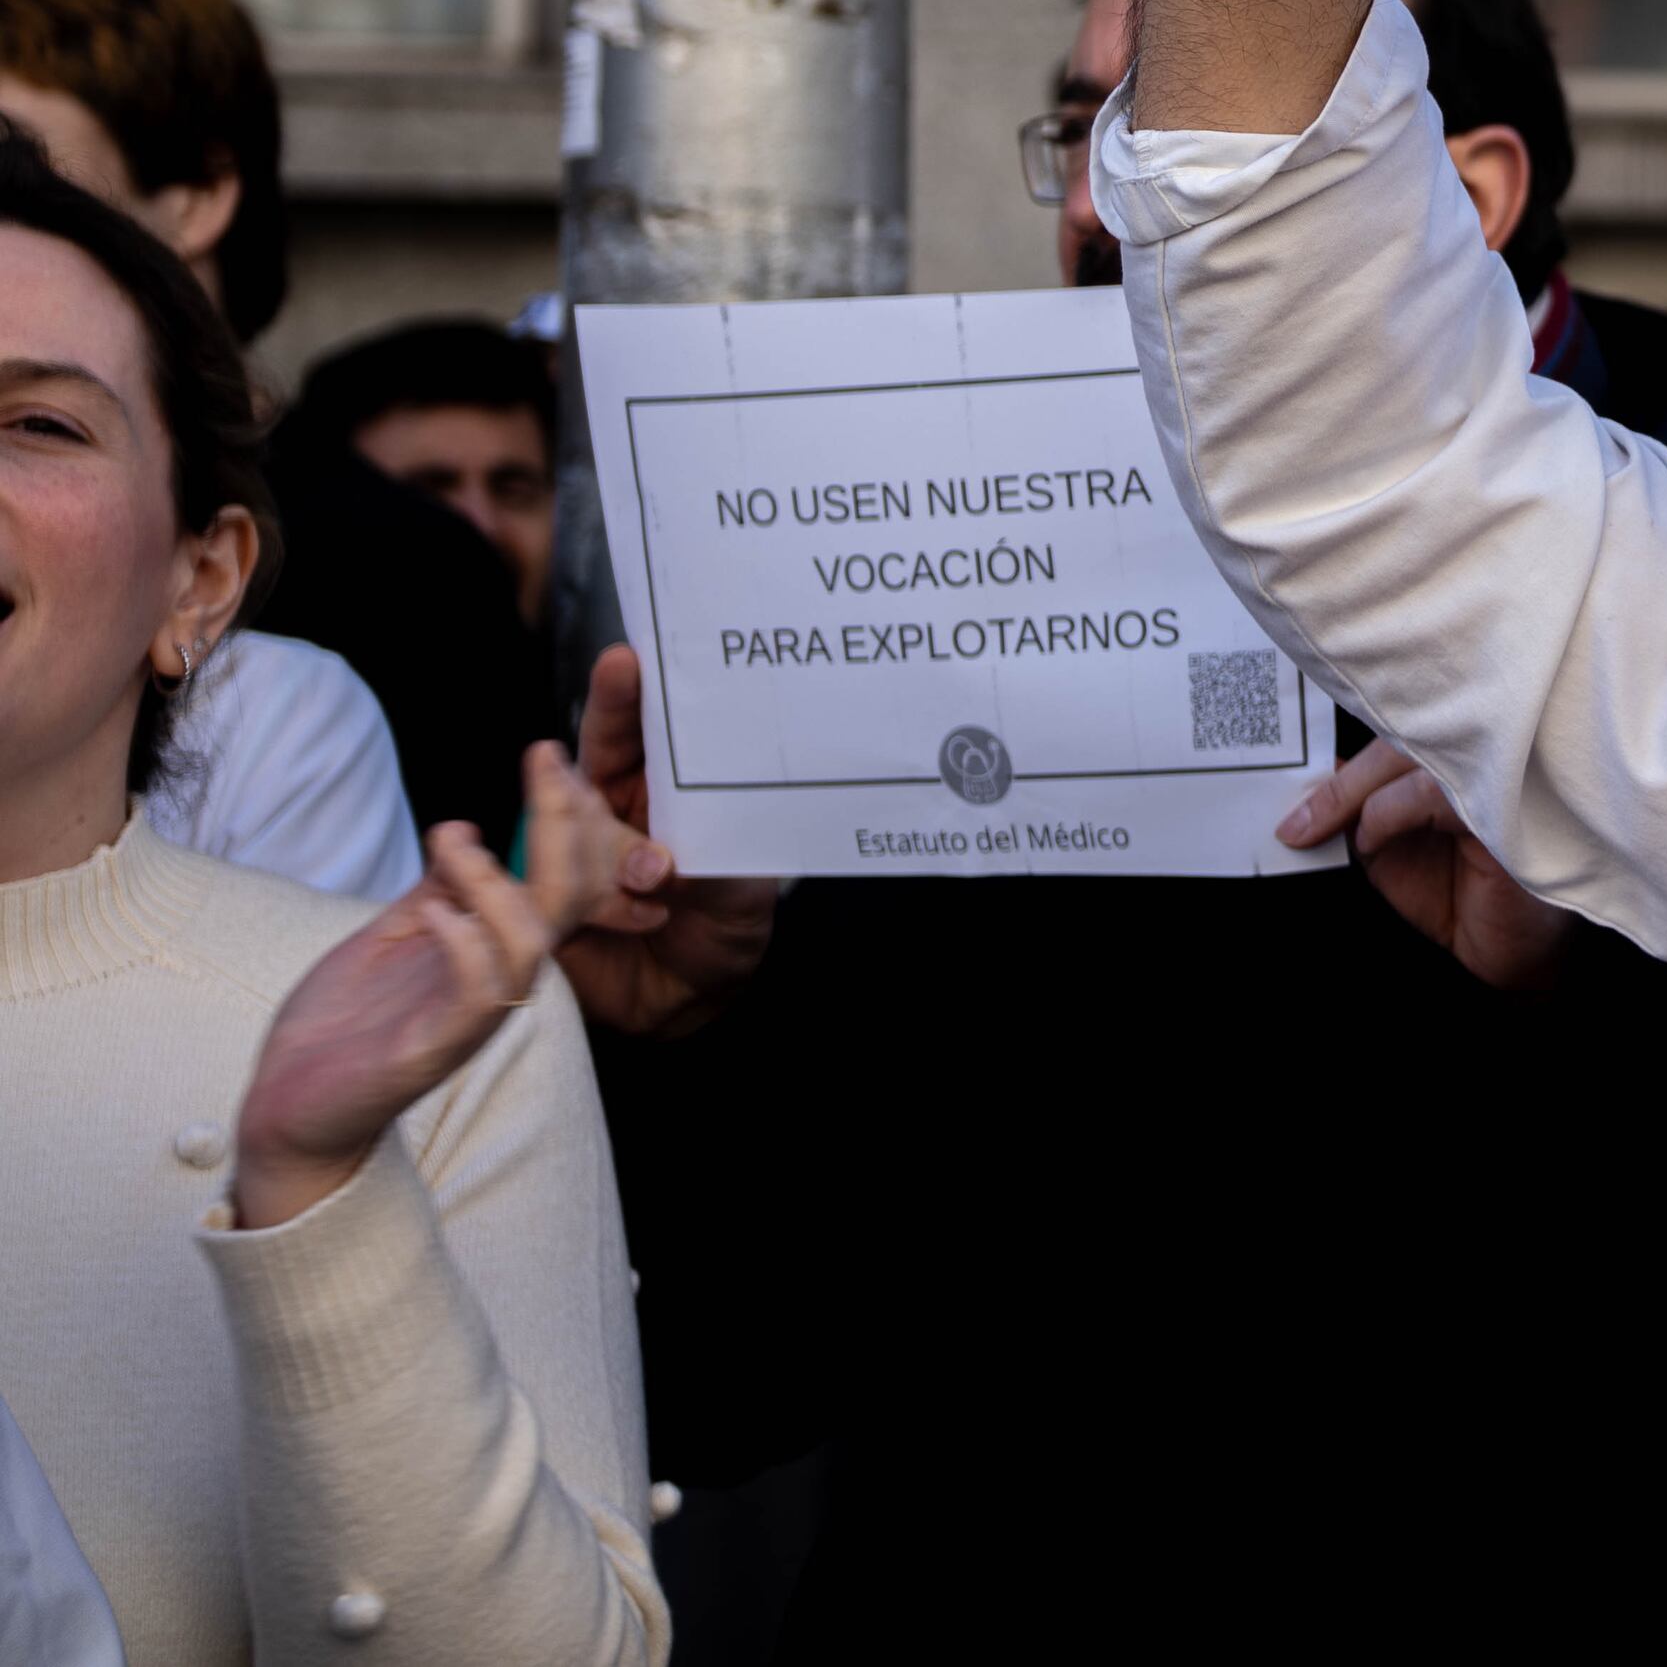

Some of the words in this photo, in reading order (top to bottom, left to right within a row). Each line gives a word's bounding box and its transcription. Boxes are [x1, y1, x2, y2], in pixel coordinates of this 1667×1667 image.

[716, 487, 778, 528] NO
[791, 481, 912, 525] USEN
[926, 467, 1153, 517] NUESTRA
[813, 537, 1057, 594] VOCACIÓN
[720, 626, 833, 668] PARA
[842, 608, 1181, 665] EXPLOTARNOS
[855, 828, 969, 859] Estatuto
[975, 824, 1020, 854] del
[1026, 821, 1131, 852] Médico
